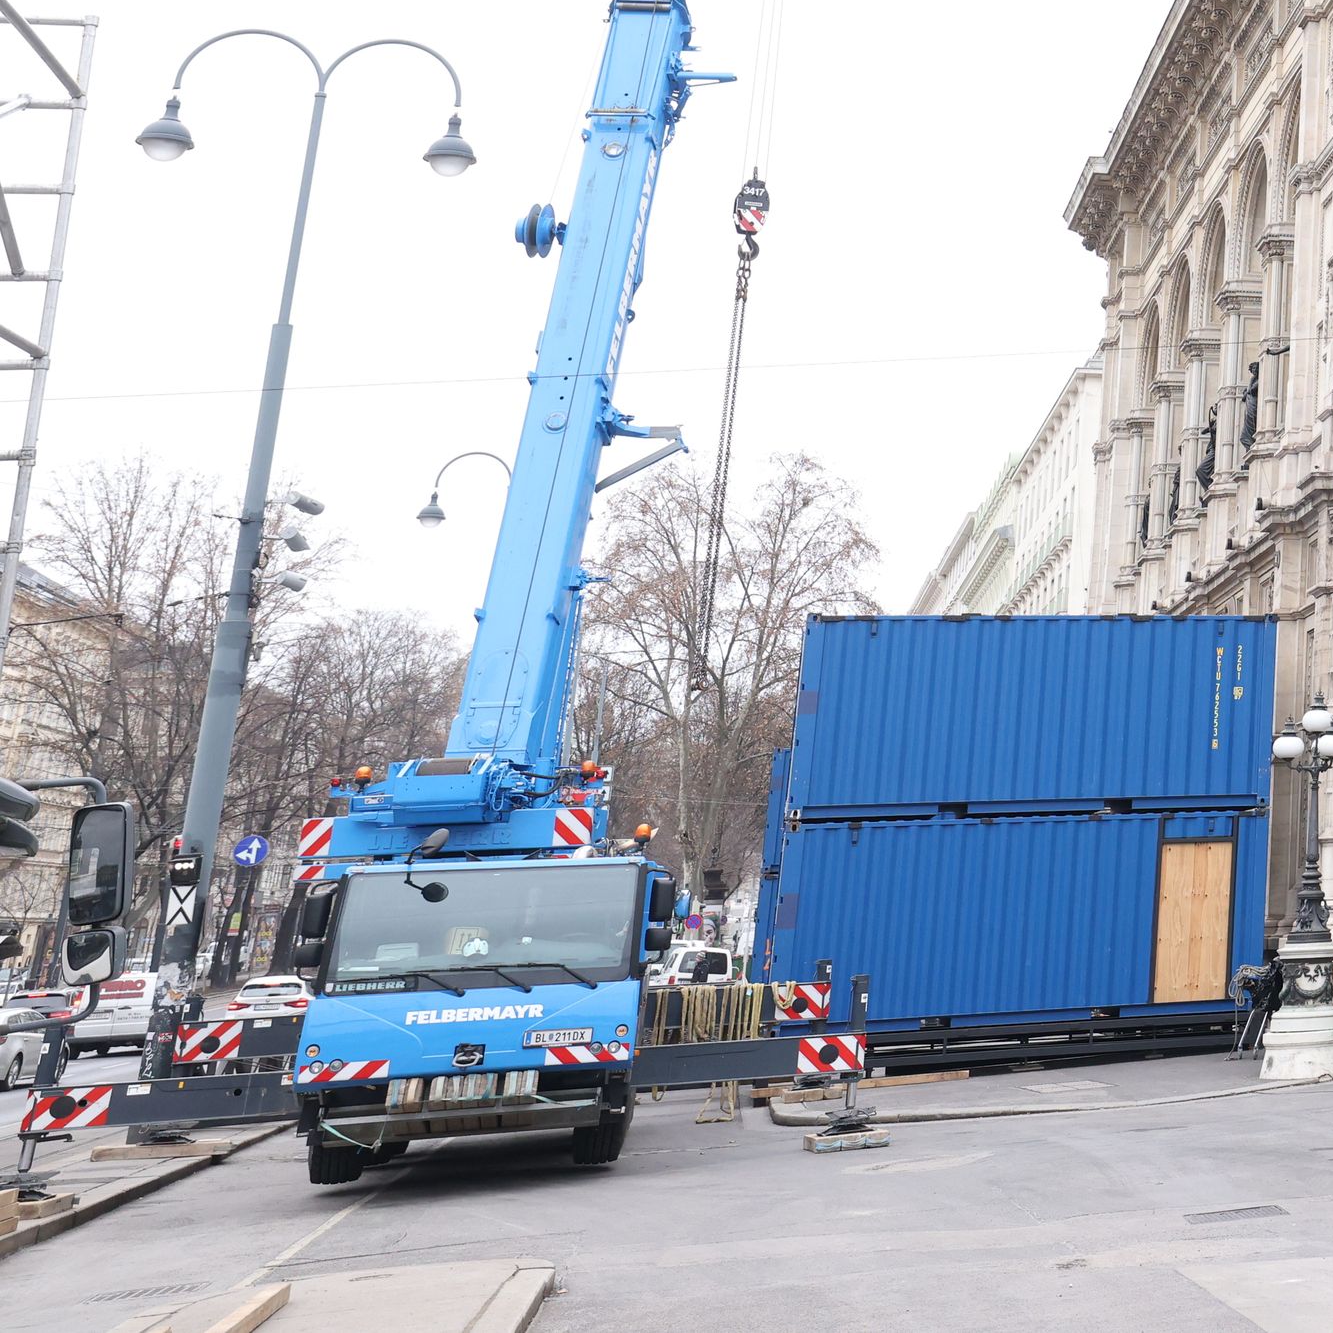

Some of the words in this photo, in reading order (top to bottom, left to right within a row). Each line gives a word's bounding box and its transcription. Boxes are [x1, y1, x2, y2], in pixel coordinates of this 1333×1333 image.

[743, 186, 766, 197] 3417
[1215, 647, 1224, 681] WCTU
[333, 980, 406, 993] LIEBHERR
[404, 1003, 543, 1026] FELBERMAYR
[535, 1033, 547, 1043] BL
